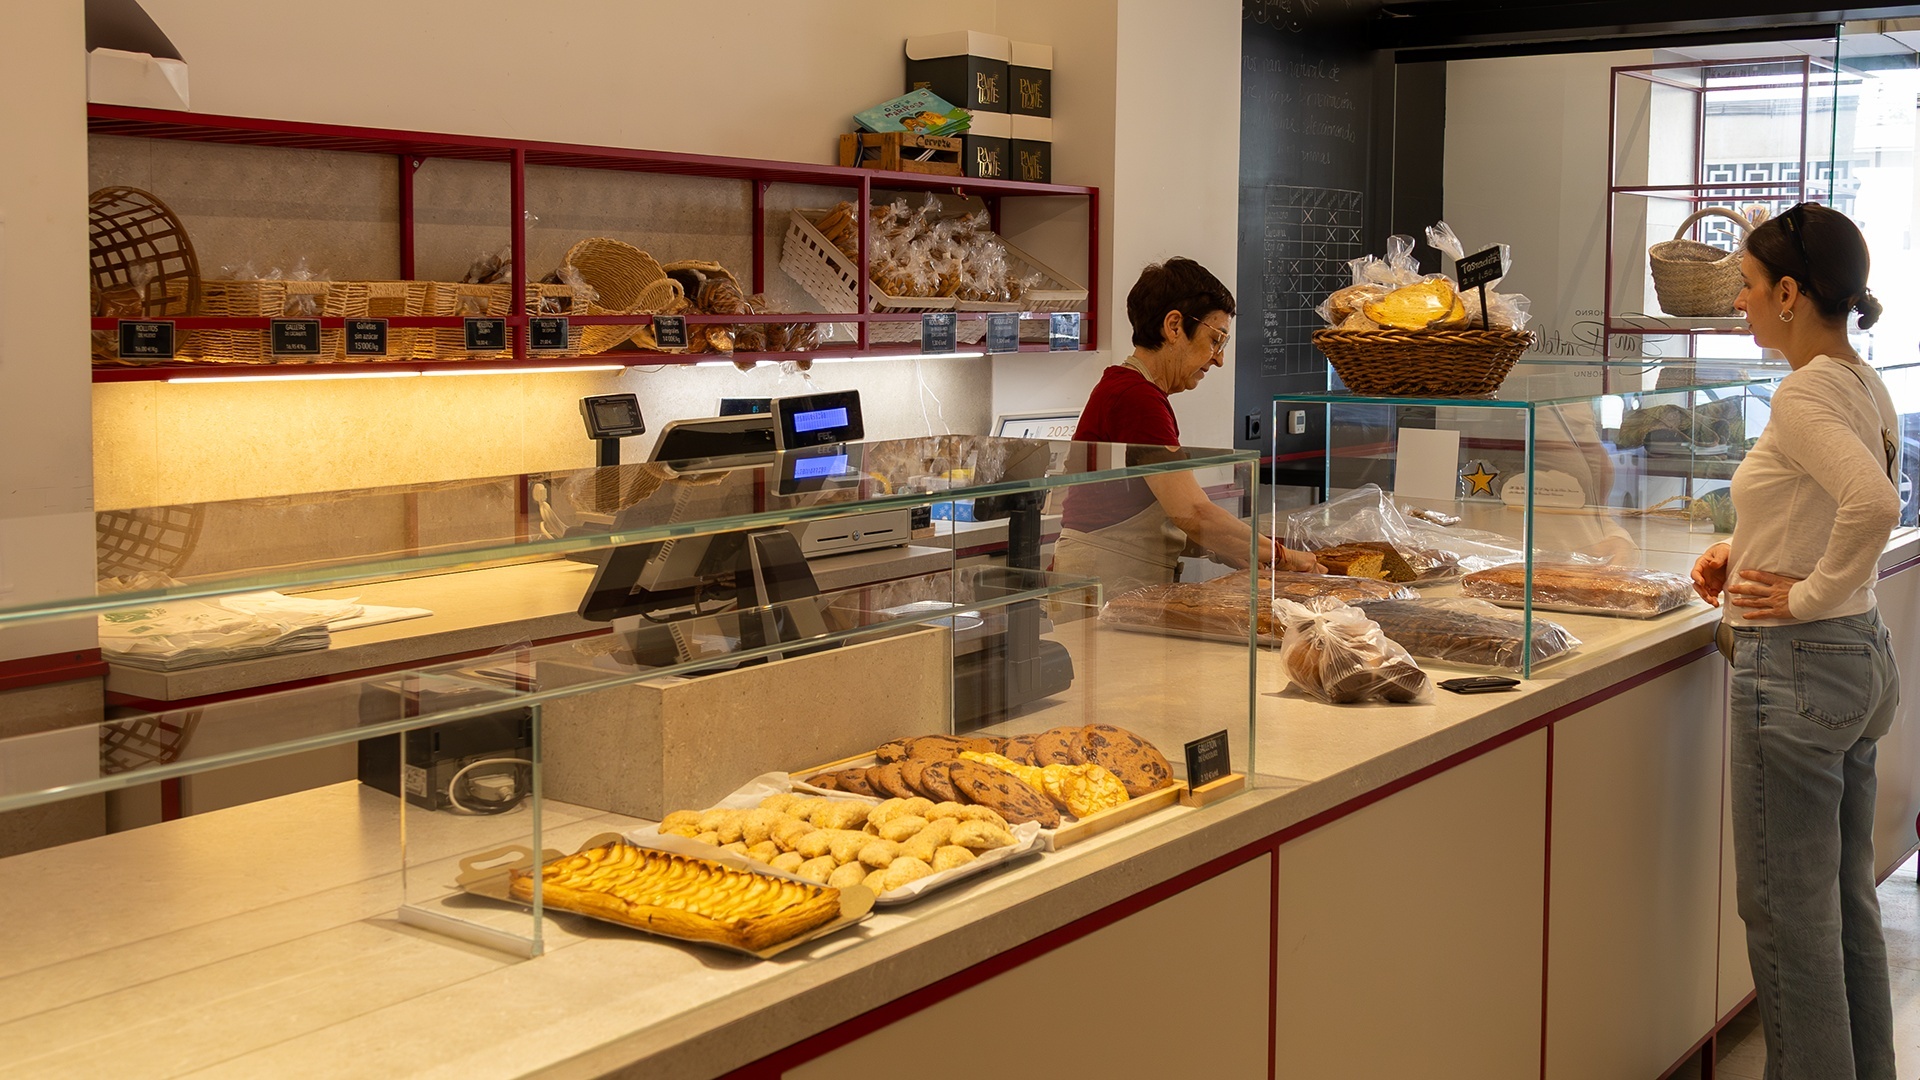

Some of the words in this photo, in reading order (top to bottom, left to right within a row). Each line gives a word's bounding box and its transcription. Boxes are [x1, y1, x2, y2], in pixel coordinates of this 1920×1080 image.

[885, 102, 925, 118] MARIPOSA
[356, 322, 377, 330] Galletas
[354, 332, 363, 340] sin
[363, 332, 379, 340] azúcar
[1047, 425, 1077, 437] 2023
